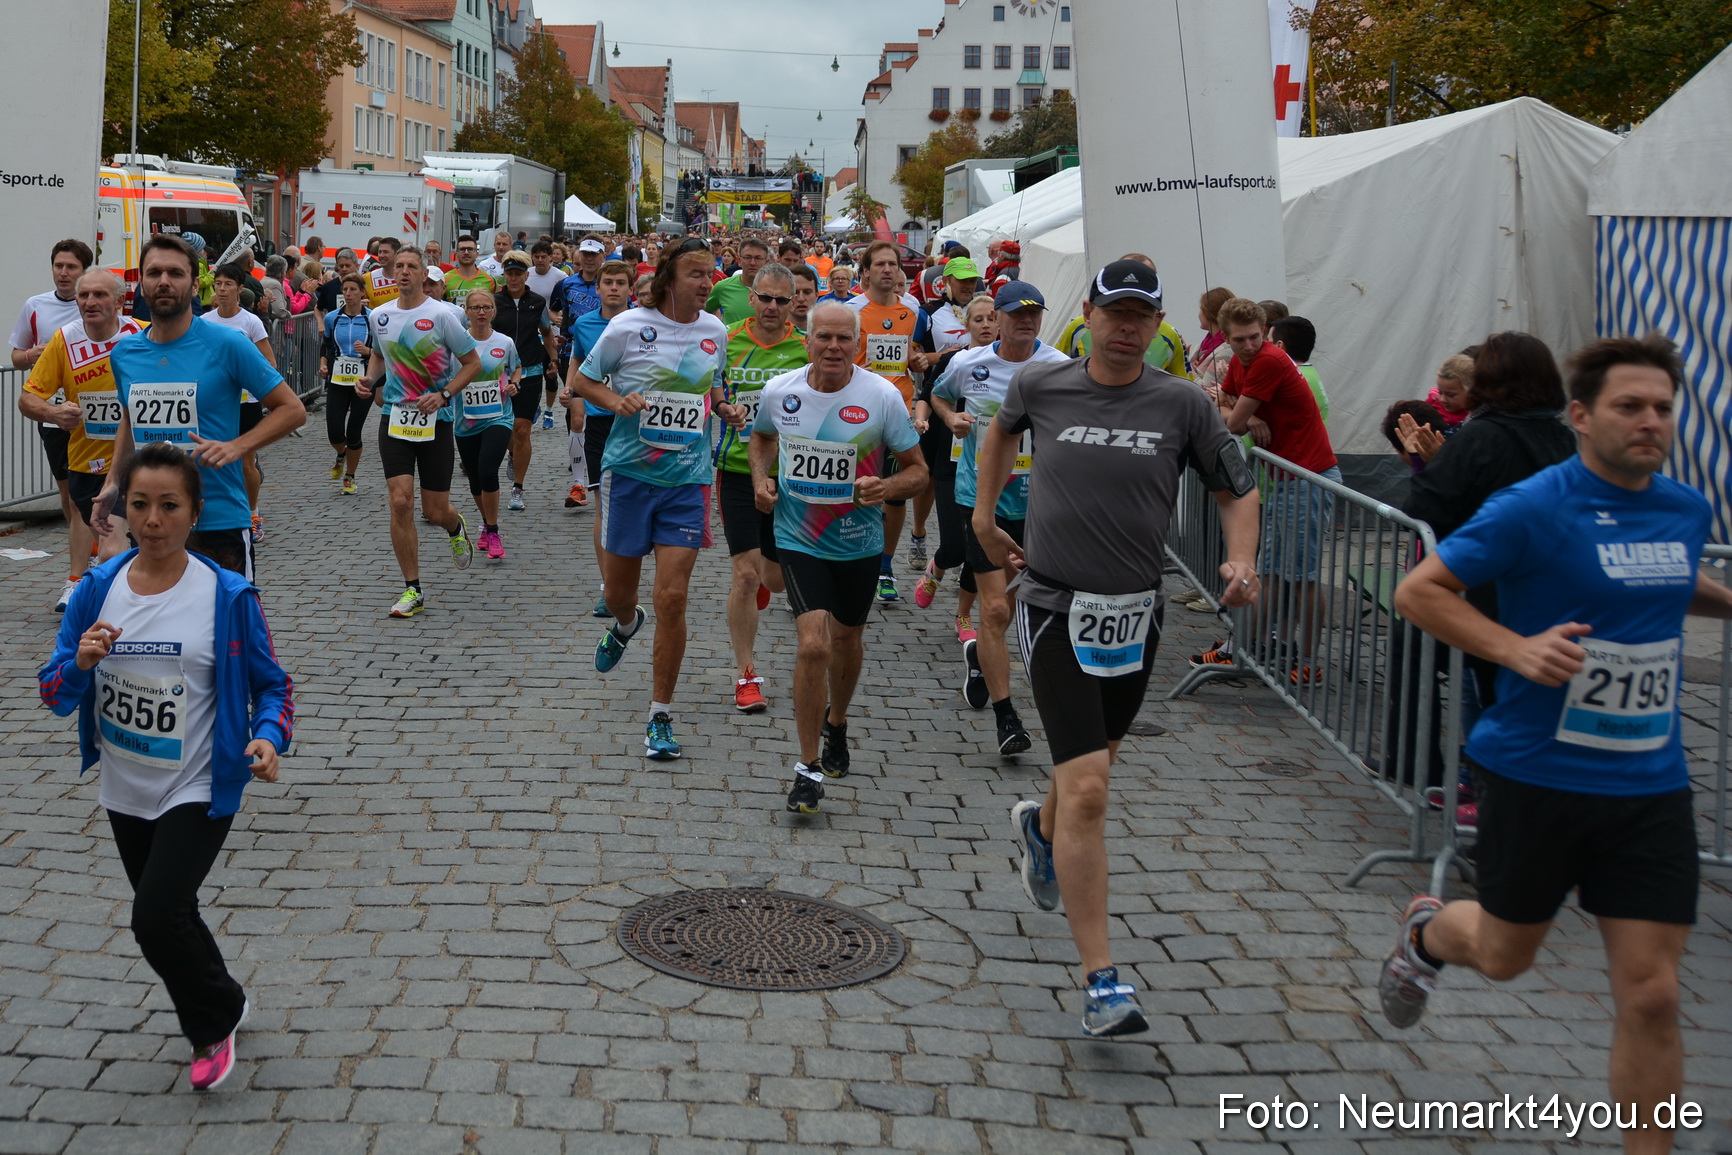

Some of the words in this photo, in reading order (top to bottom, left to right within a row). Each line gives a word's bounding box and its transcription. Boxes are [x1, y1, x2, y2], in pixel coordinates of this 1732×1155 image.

[1115, 173, 1276, 195] www.bmw-laufsport.de
[734, 194, 764, 202] START
[352, 203, 393, 212] Bayerisches
[876, 345, 902, 361] 346
[340, 363, 359, 376] 166
[875, 363, 900, 372] Matthias
[74, 364, 109, 386] MAX
[131, 389, 152, 397] PARTL
[153, 388, 185, 398] Neumarkt
[466, 390, 499, 407] 3102
[666, 398, 695, 406] Neumarkt
[135, 400, 192, 425] 2276
[400, 411, 430, 427] 373
[647, 406, 699, 430] 2642
[843, 409, 866, 421] Hervis
[144, 430, 183, 442] Bernhard
[402, 428, 424, 437] Harald
[657, 433, 684, 443] Achim
[1056, 425, 1163, 449] ARZT
[788, 443, 811, 453] PARTL
[811, 445, 845, 456] Neumarkt
[1131, 447, 1158, 456] REISEN
[792, 453, 850, 481] 2048
[792, 483, 846, 496] Hans-Dieter
[839, 517, 856, 527] 16.
[1595, 541, 1689, 566] HUBER
[1622, 565, 1686, 576] TECHNOLOGY
[1075, 599, 1105, 611] PARTL
[1106, 602, 1141, 611] Neumarkt
[1078, 611, 1145, 646] 2607
[114, 643, 178, 654] BÜSCHEL
[1091, 650, 1127, 665] Helmut
[96, 666, 121, 685] PARTL
[121, 679, 168, 696] Neumarkt
[1581, 667, 1671, 710] 2193
[101, 683, 177, 733] 2556
[1596, 716, 1651, 736] Herbert
[113, 729, 150, 752] Maika
